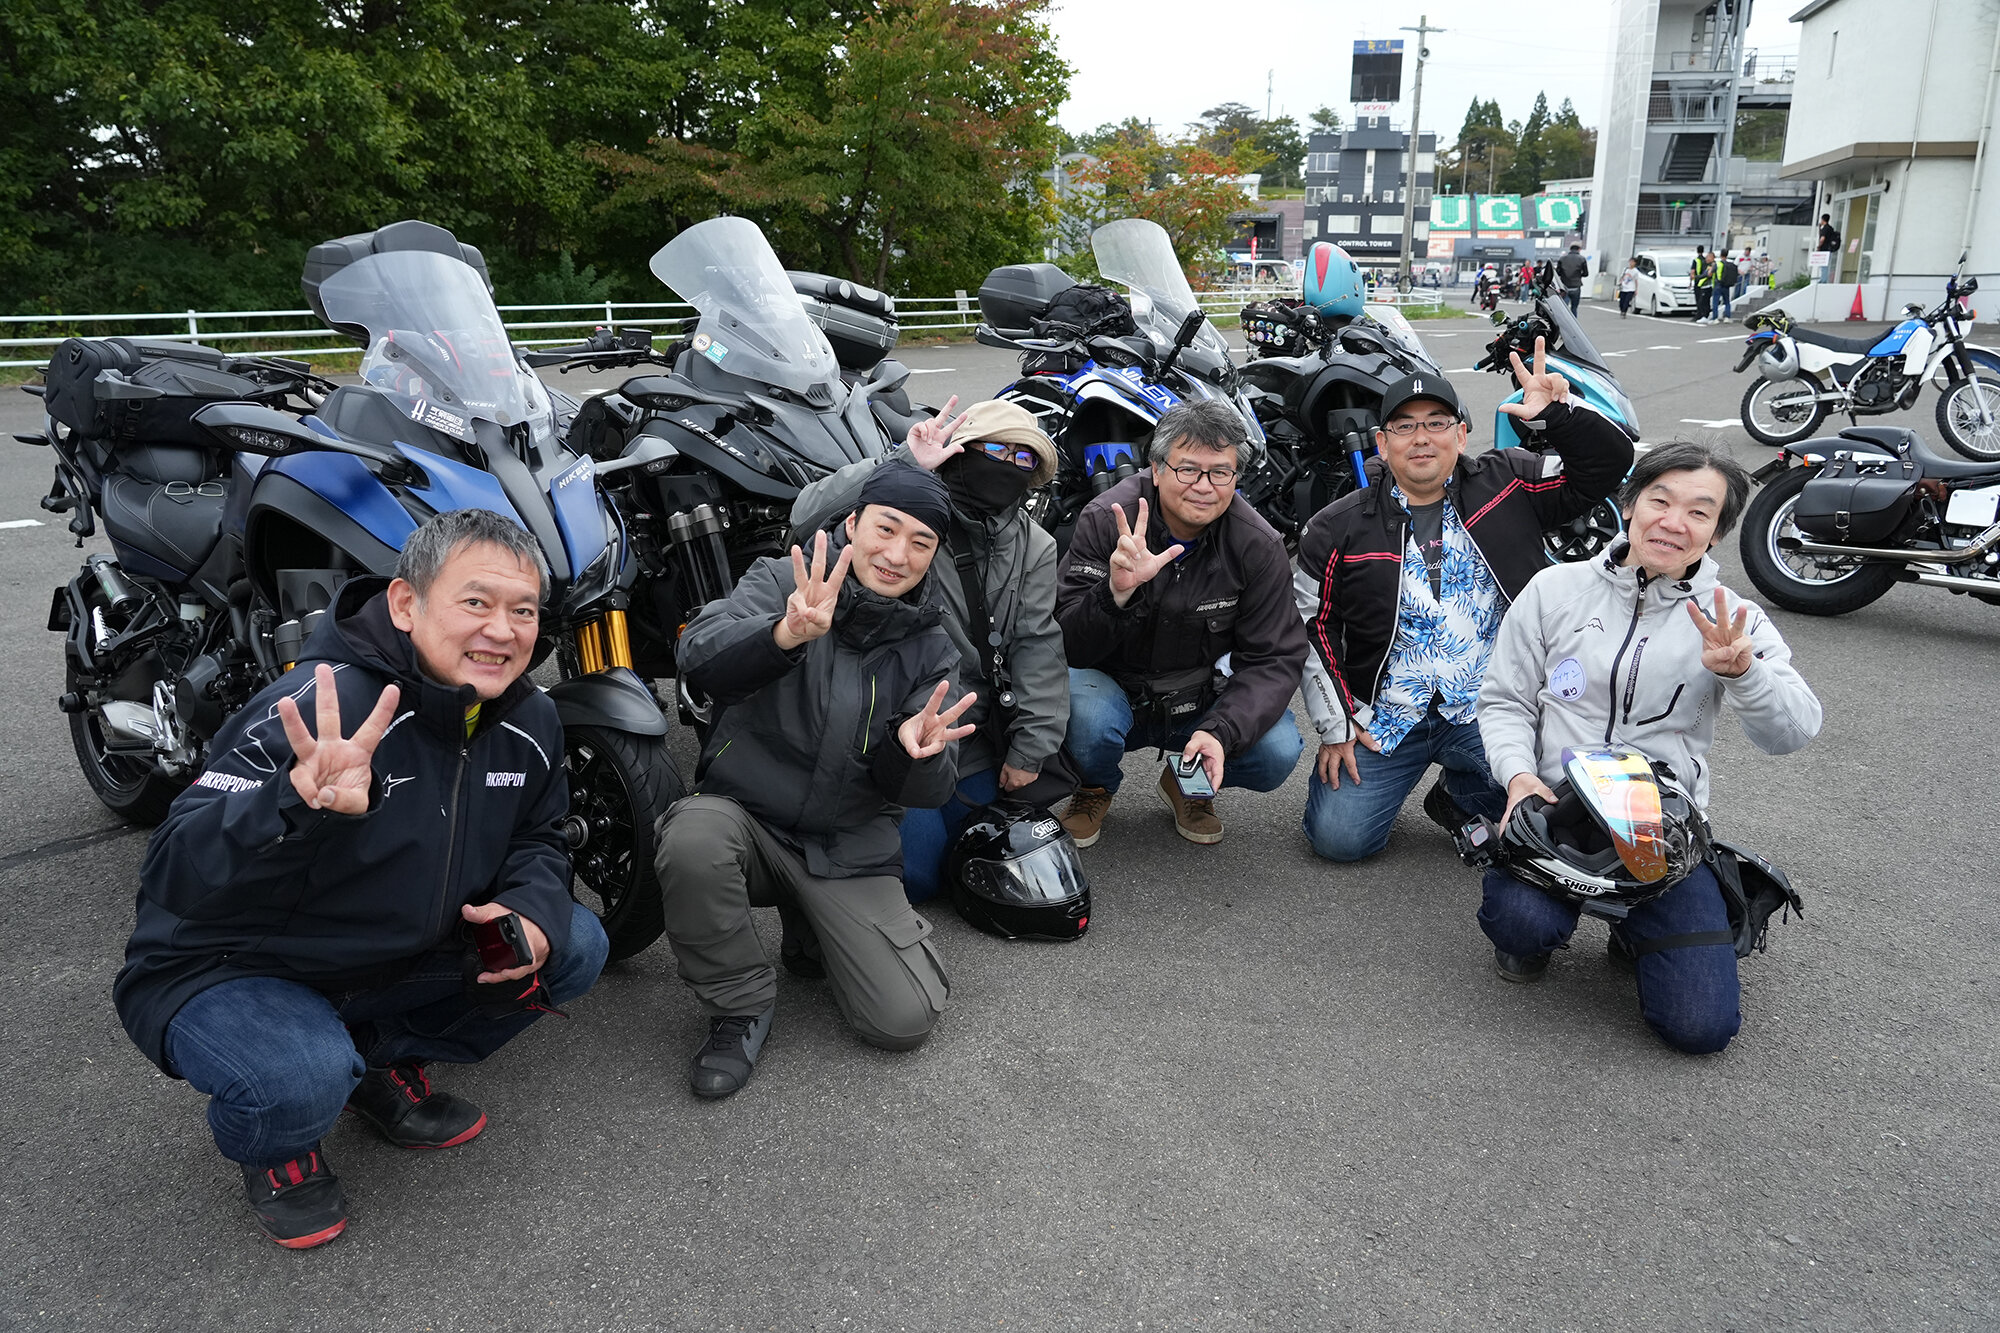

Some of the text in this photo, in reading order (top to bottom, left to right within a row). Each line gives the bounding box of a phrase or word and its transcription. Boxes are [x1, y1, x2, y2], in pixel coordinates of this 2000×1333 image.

[449, 426, 464, 437] CLUB
[680, 418, 747, 458] NIKEN GT
[558, 461, 590, 489] NIKEN
[580, 469, 592, 482] GT
[1312, 674, 1337, 717] KOMINE
[1564, 879, 1599, 894] SHOEI
